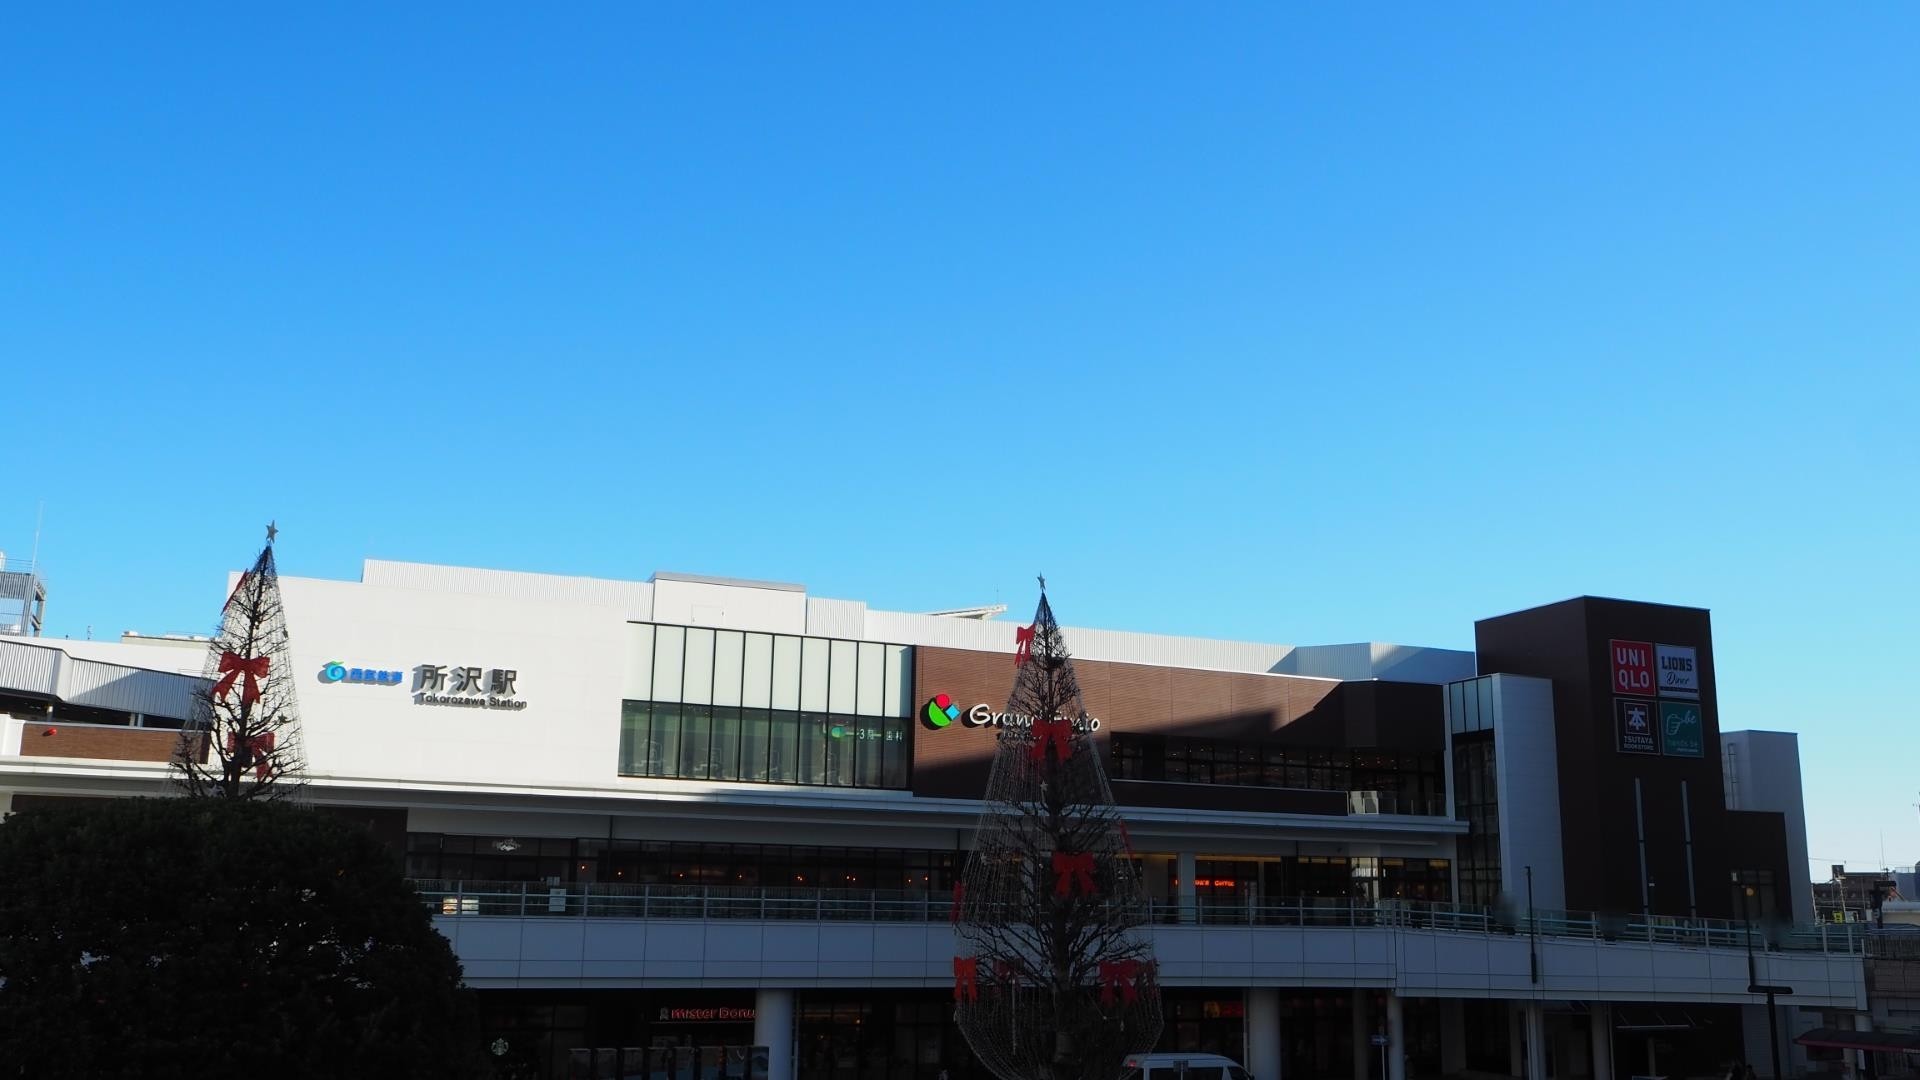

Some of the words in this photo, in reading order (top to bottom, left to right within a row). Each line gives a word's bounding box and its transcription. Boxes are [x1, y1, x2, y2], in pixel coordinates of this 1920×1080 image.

[1616, 647, 1646, 667] UNI
[1661, 656, 1693, 672] LIONS
[418, 664, 517, 695] 所沢駅
[1618, 669, 1650, 690] QLO
[420, 693, 486, 706] Tokorozawa
[489, 697, 527, 709] Station
[969, 703, 1045, 727] Gran
[1628, 707, 1646, 731] 本
[1623, 735, 1654, 745] TSUTAYA
[719, 1007, 757, 1020] Donu
